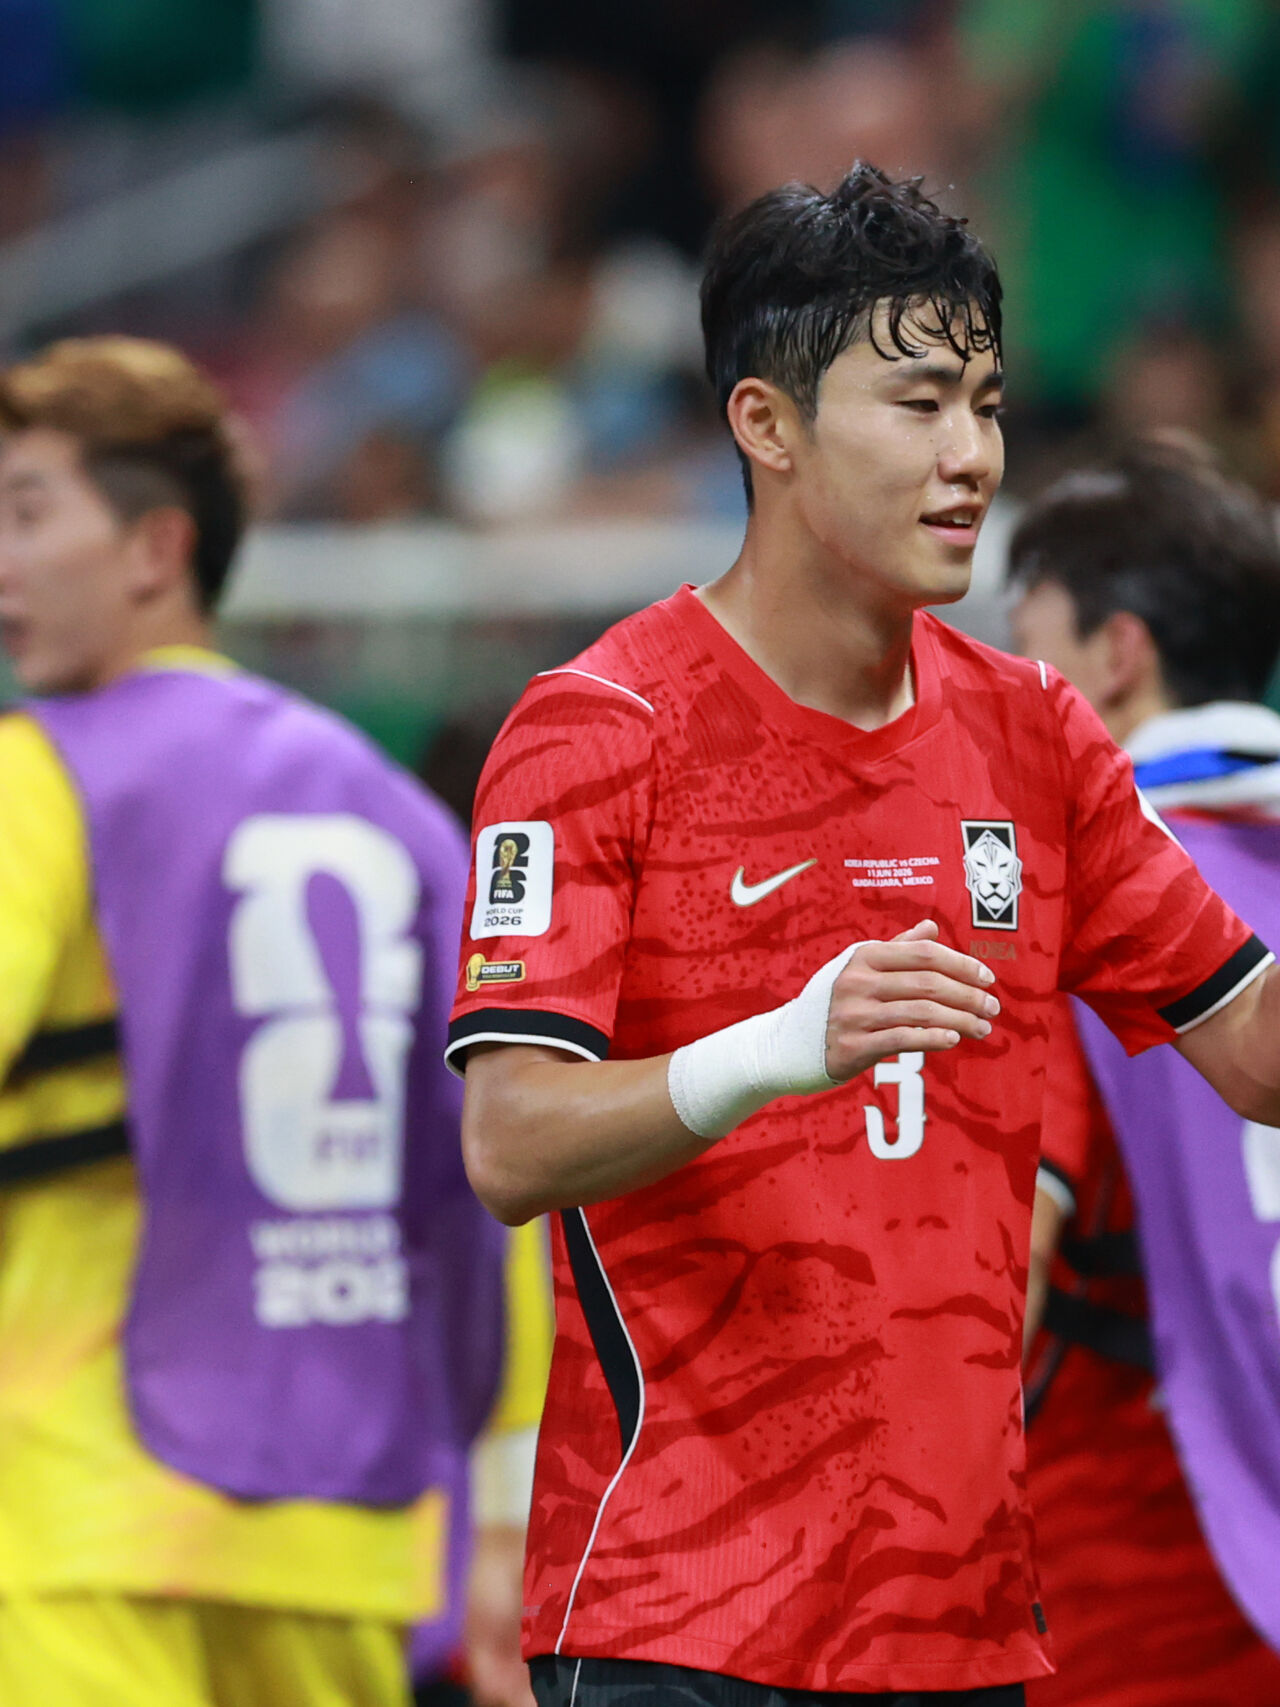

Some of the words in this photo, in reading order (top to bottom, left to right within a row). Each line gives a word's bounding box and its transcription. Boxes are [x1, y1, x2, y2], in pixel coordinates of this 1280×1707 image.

[908, 857, 939, 866] CZECHIA
[876, 869, 892, 877] JUN
[903, 876, 934, 886] MEXICO
[494, 889, 514, 899] FIFA
[484, 916, 522, 927] 2026
[969, 940, 1017, 961] KOREA
[481, 964, 520, 974] DEBUT
[864, 1051, 928, 1160] 3
